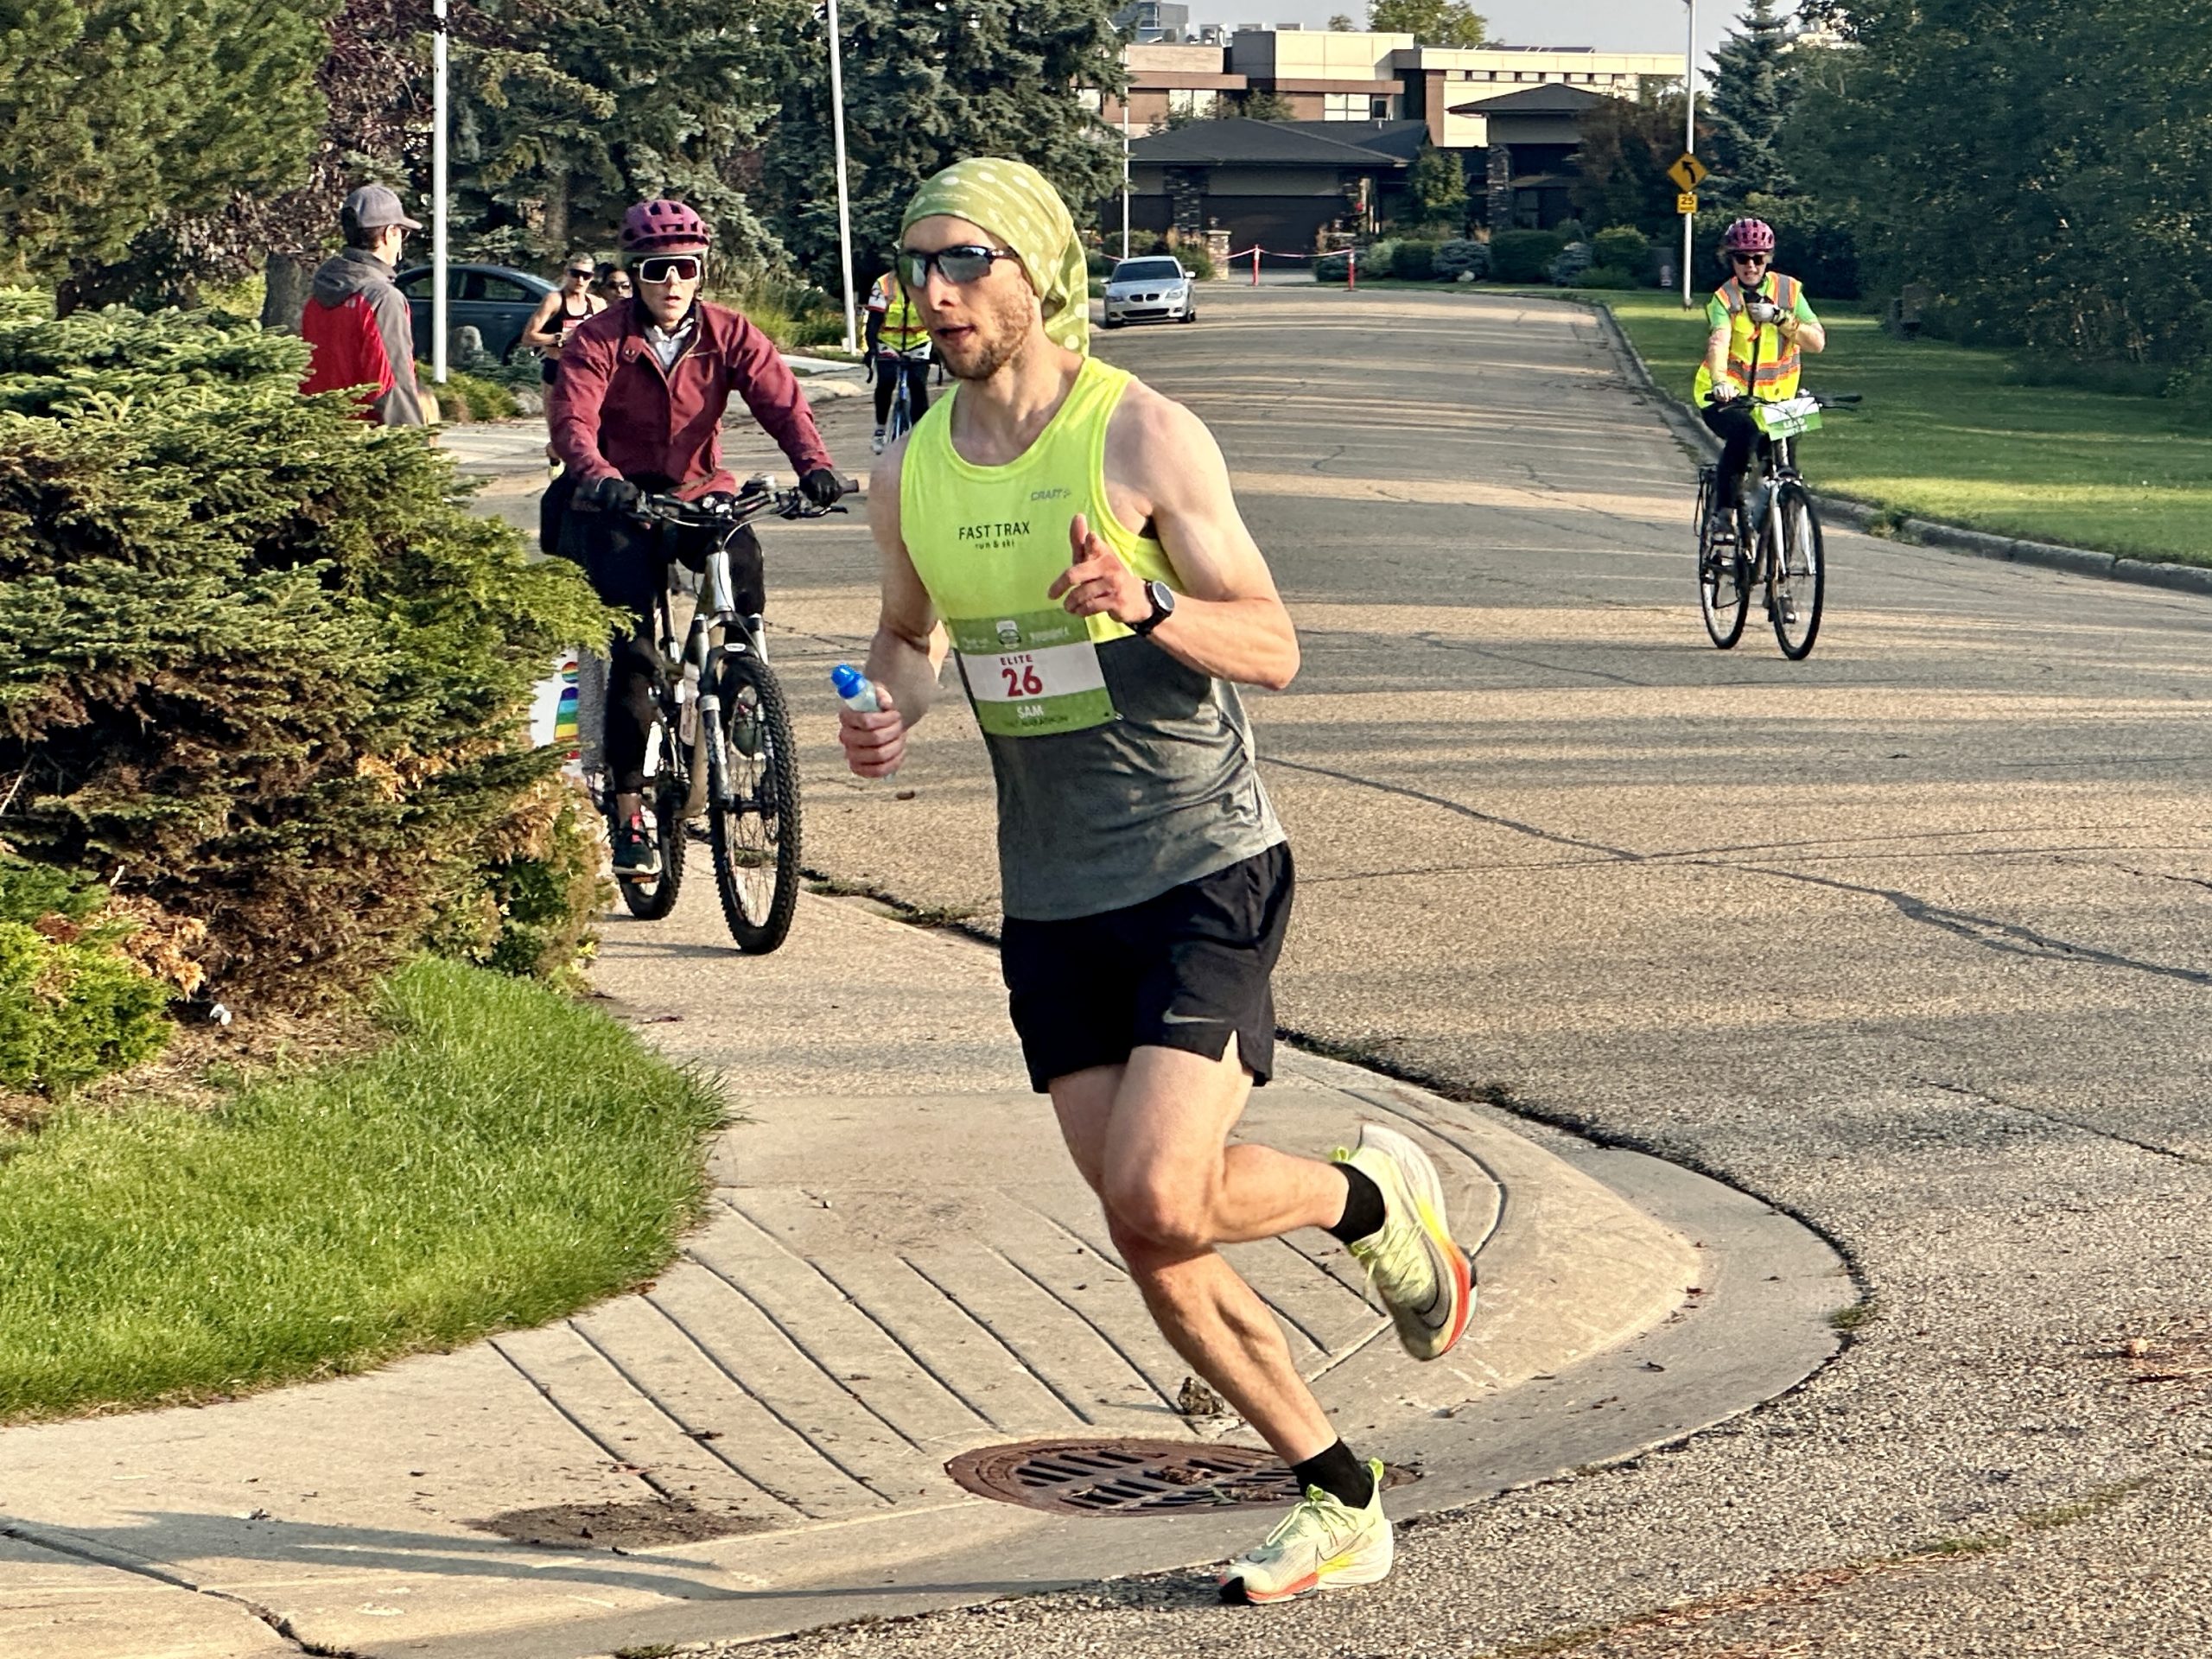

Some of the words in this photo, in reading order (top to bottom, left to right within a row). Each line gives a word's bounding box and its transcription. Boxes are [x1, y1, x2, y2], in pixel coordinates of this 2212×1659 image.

[1681, 196, 1694, 205] 25
[958, 524, 990, 540] FAST
[995, 521, 1030, 537] TRAX
[975, 541, 990, 550] run
[993, 540, 999, 549] &
[1000, 654, 1033, 666] ELITE
[1001, 665, 1043, 697] 26
[1016, 705, 1044, 720] SAM
